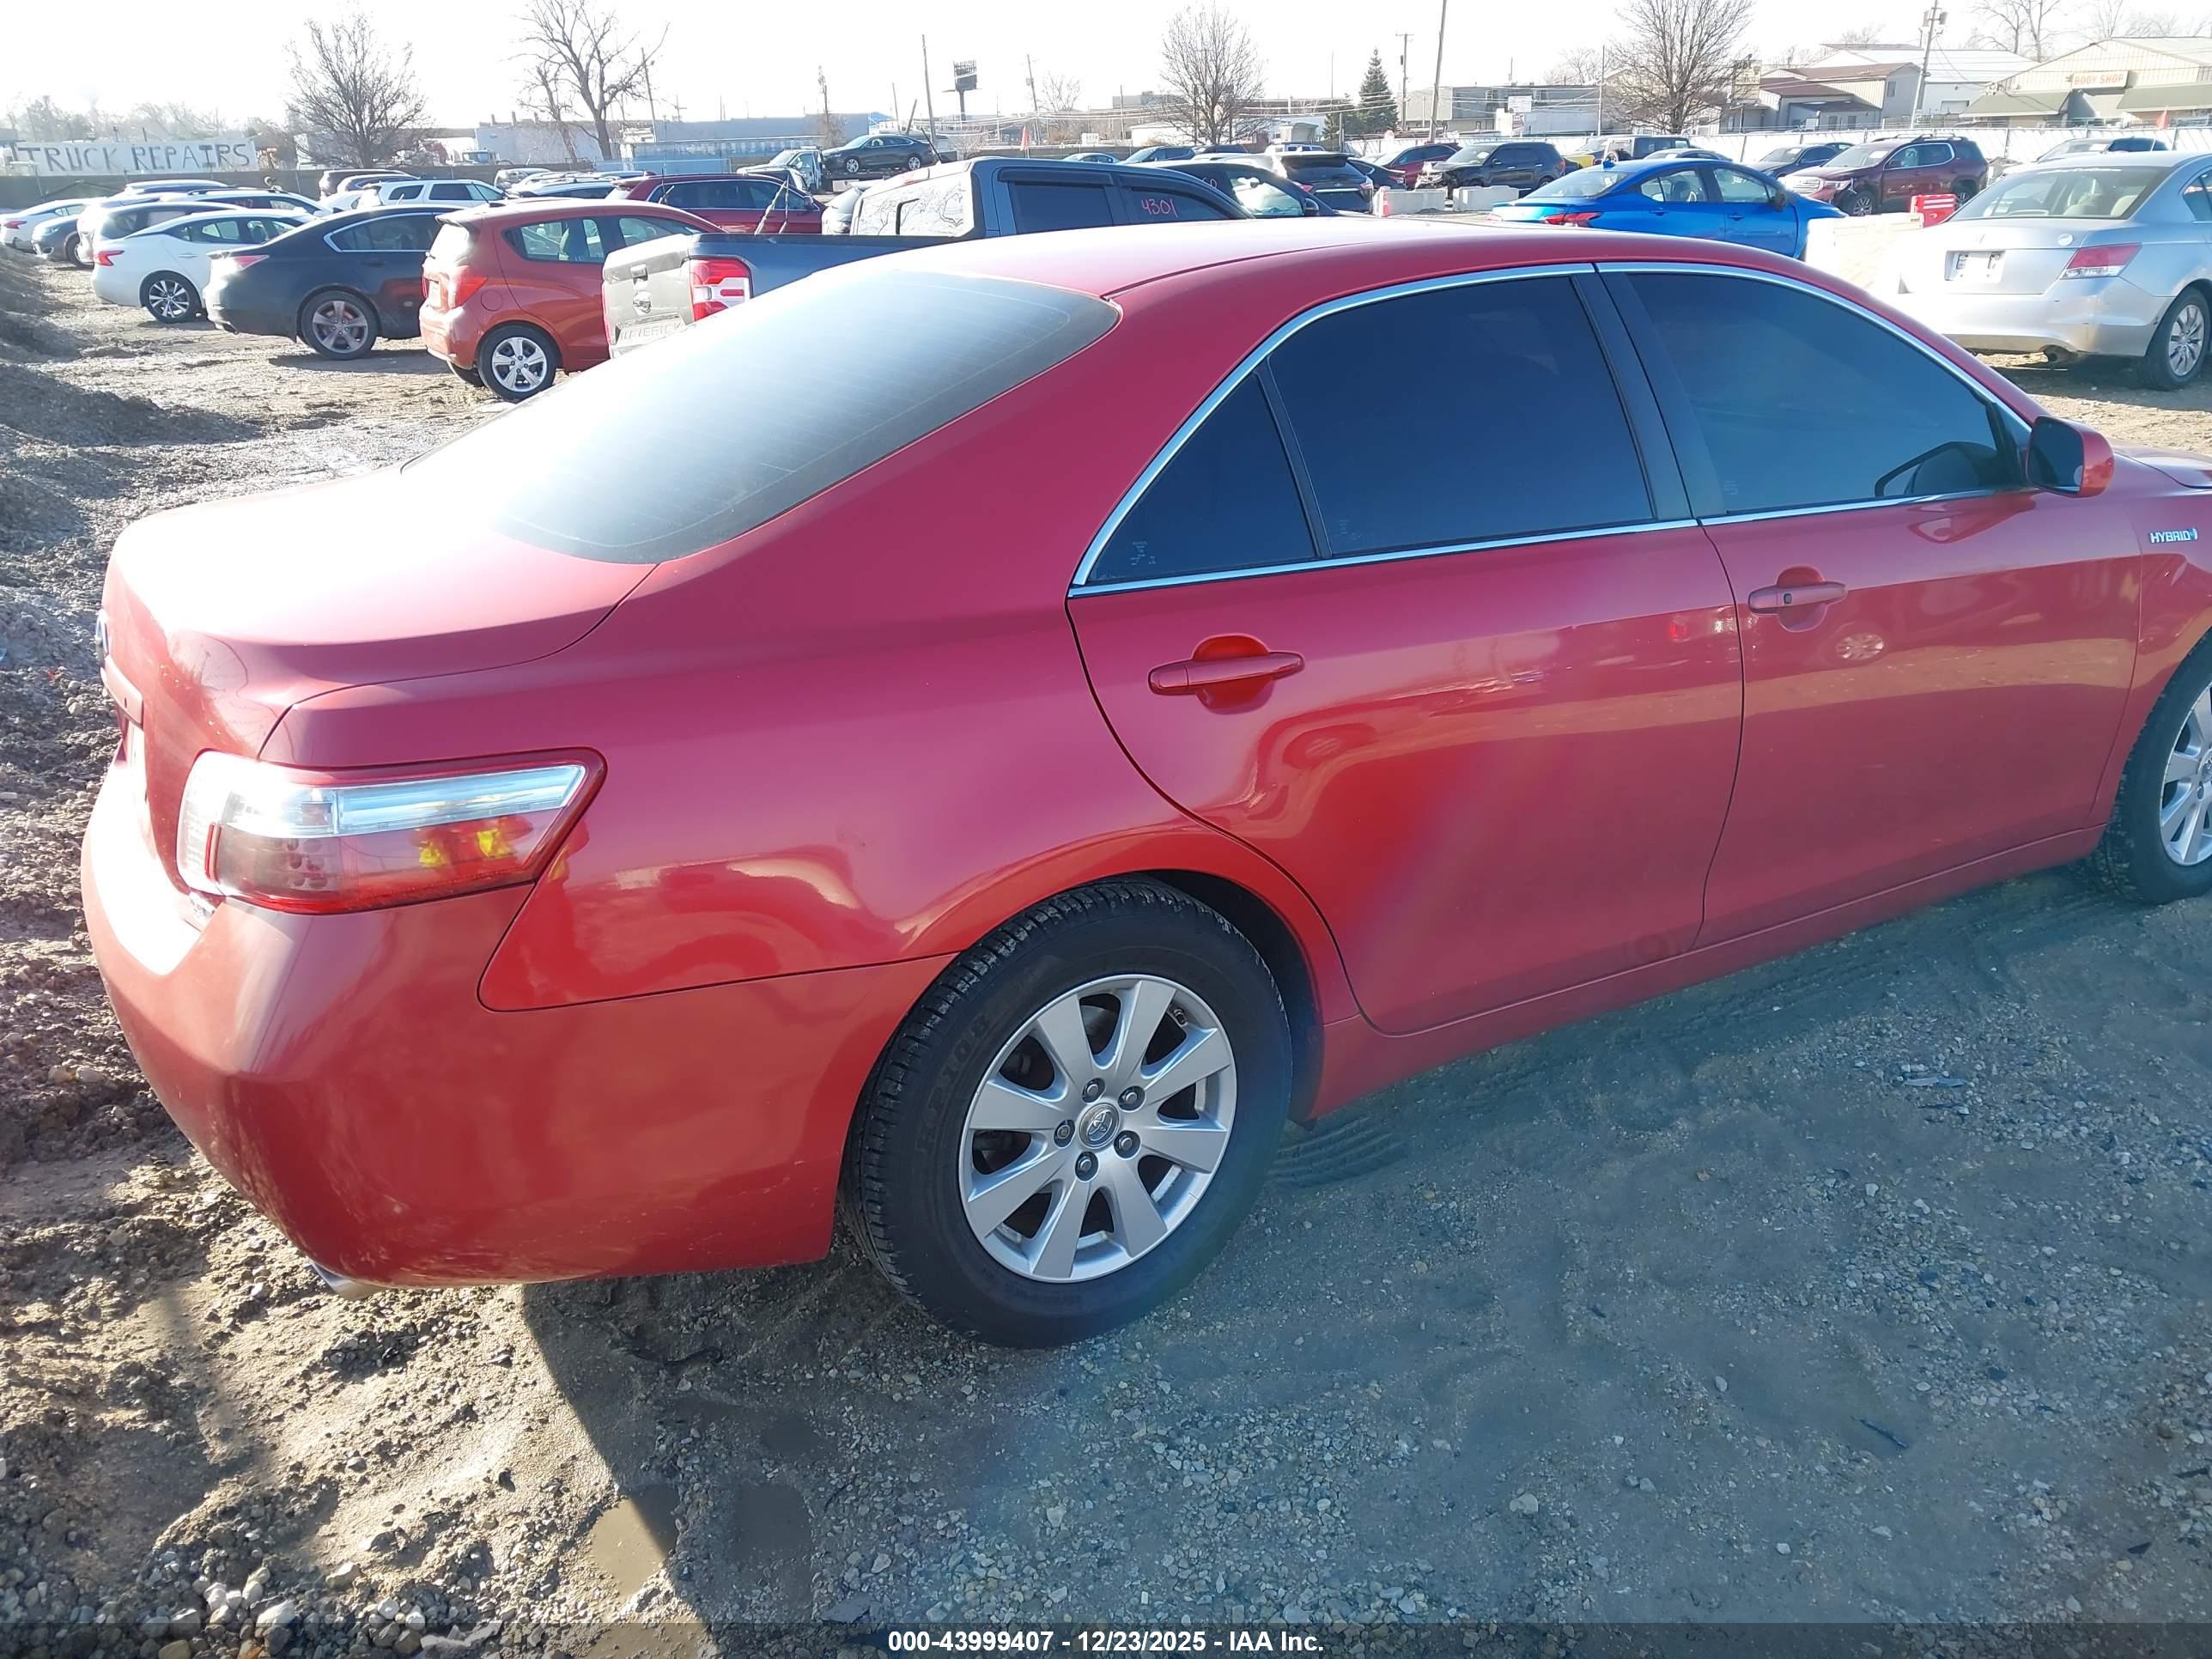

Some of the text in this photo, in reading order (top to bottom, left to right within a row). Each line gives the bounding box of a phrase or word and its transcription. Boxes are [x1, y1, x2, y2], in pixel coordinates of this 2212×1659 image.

[2075, 73, 2124, 85] BODY SHOP
[17, 143, 250, 172] TRUCK REPAIRS
[1141, 198, 1178, 218] 4301
[2149, 530, 2191, 544] HYBRID
